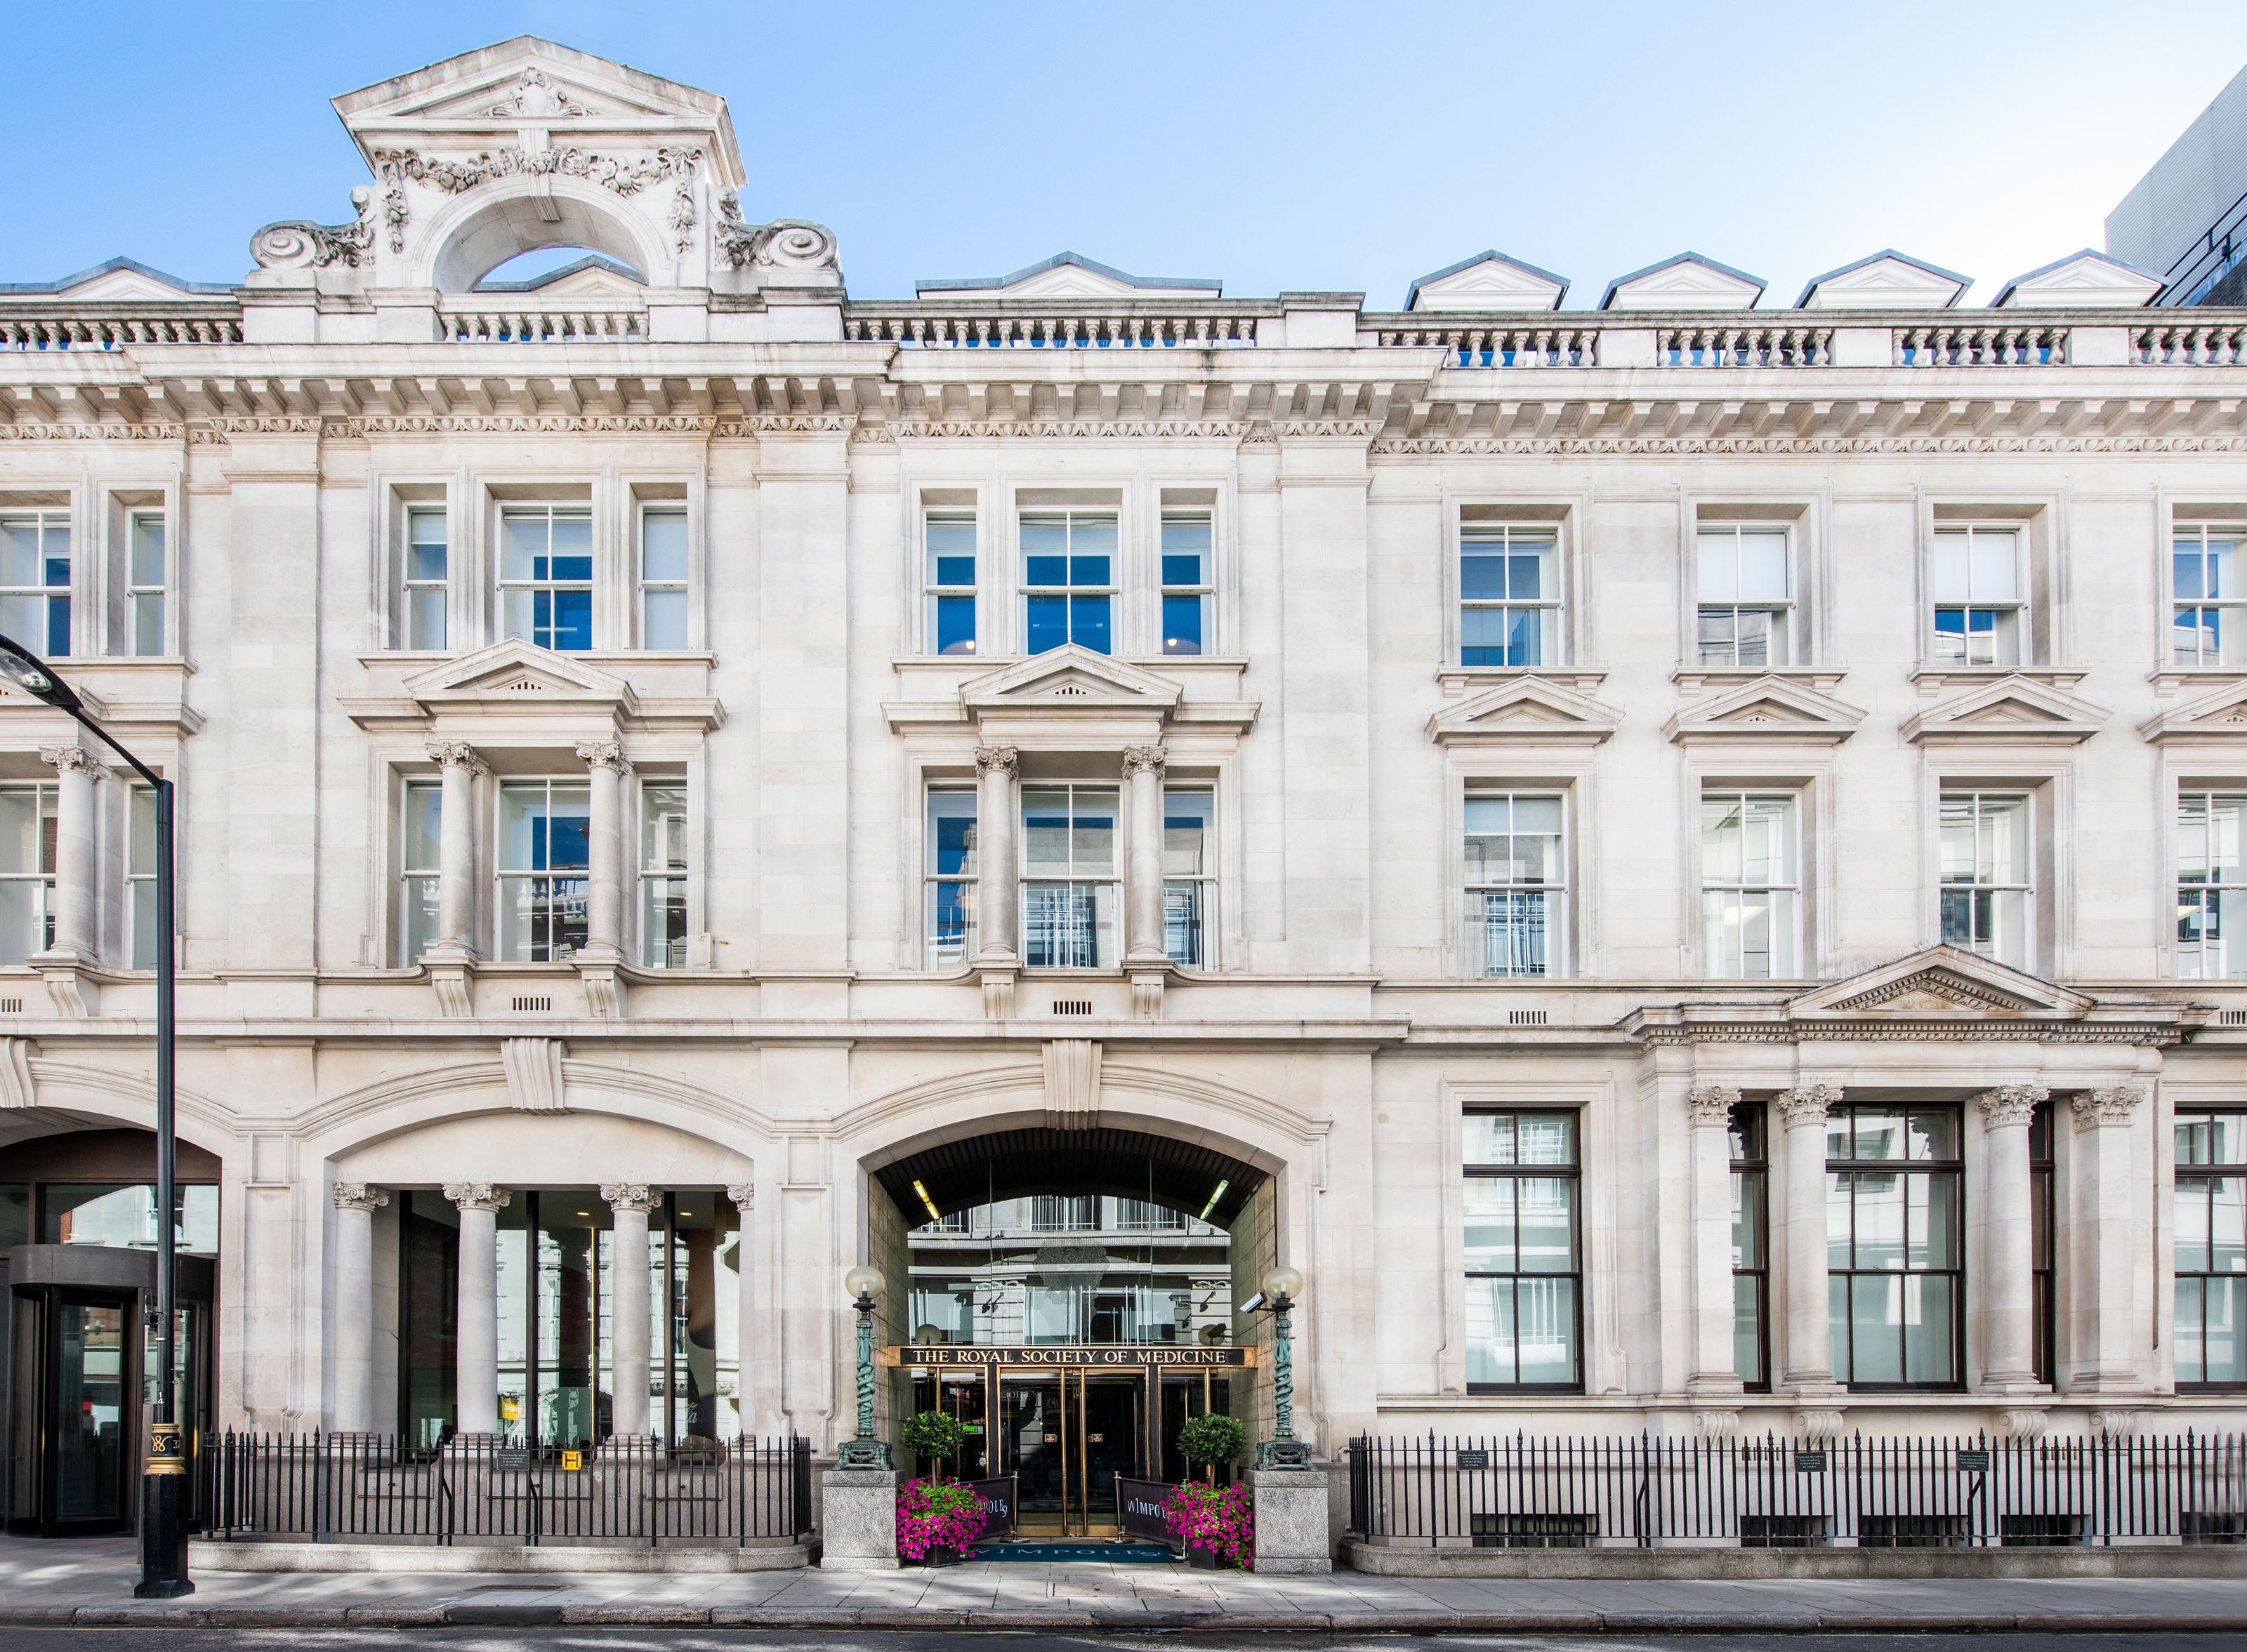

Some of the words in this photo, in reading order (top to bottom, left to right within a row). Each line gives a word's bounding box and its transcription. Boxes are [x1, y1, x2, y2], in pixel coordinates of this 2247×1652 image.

[913, 1350, 949, 1363] THE
[956, 1350, 1013, 1363] ROYAL
[1021, 1350, 1098, 1363] SOCIETY
[1104, 1350, 1128, 1363] OF
[1136, 1350, 1226, 1363] MEDICINE
[565, 1453, 579, 1468] H
